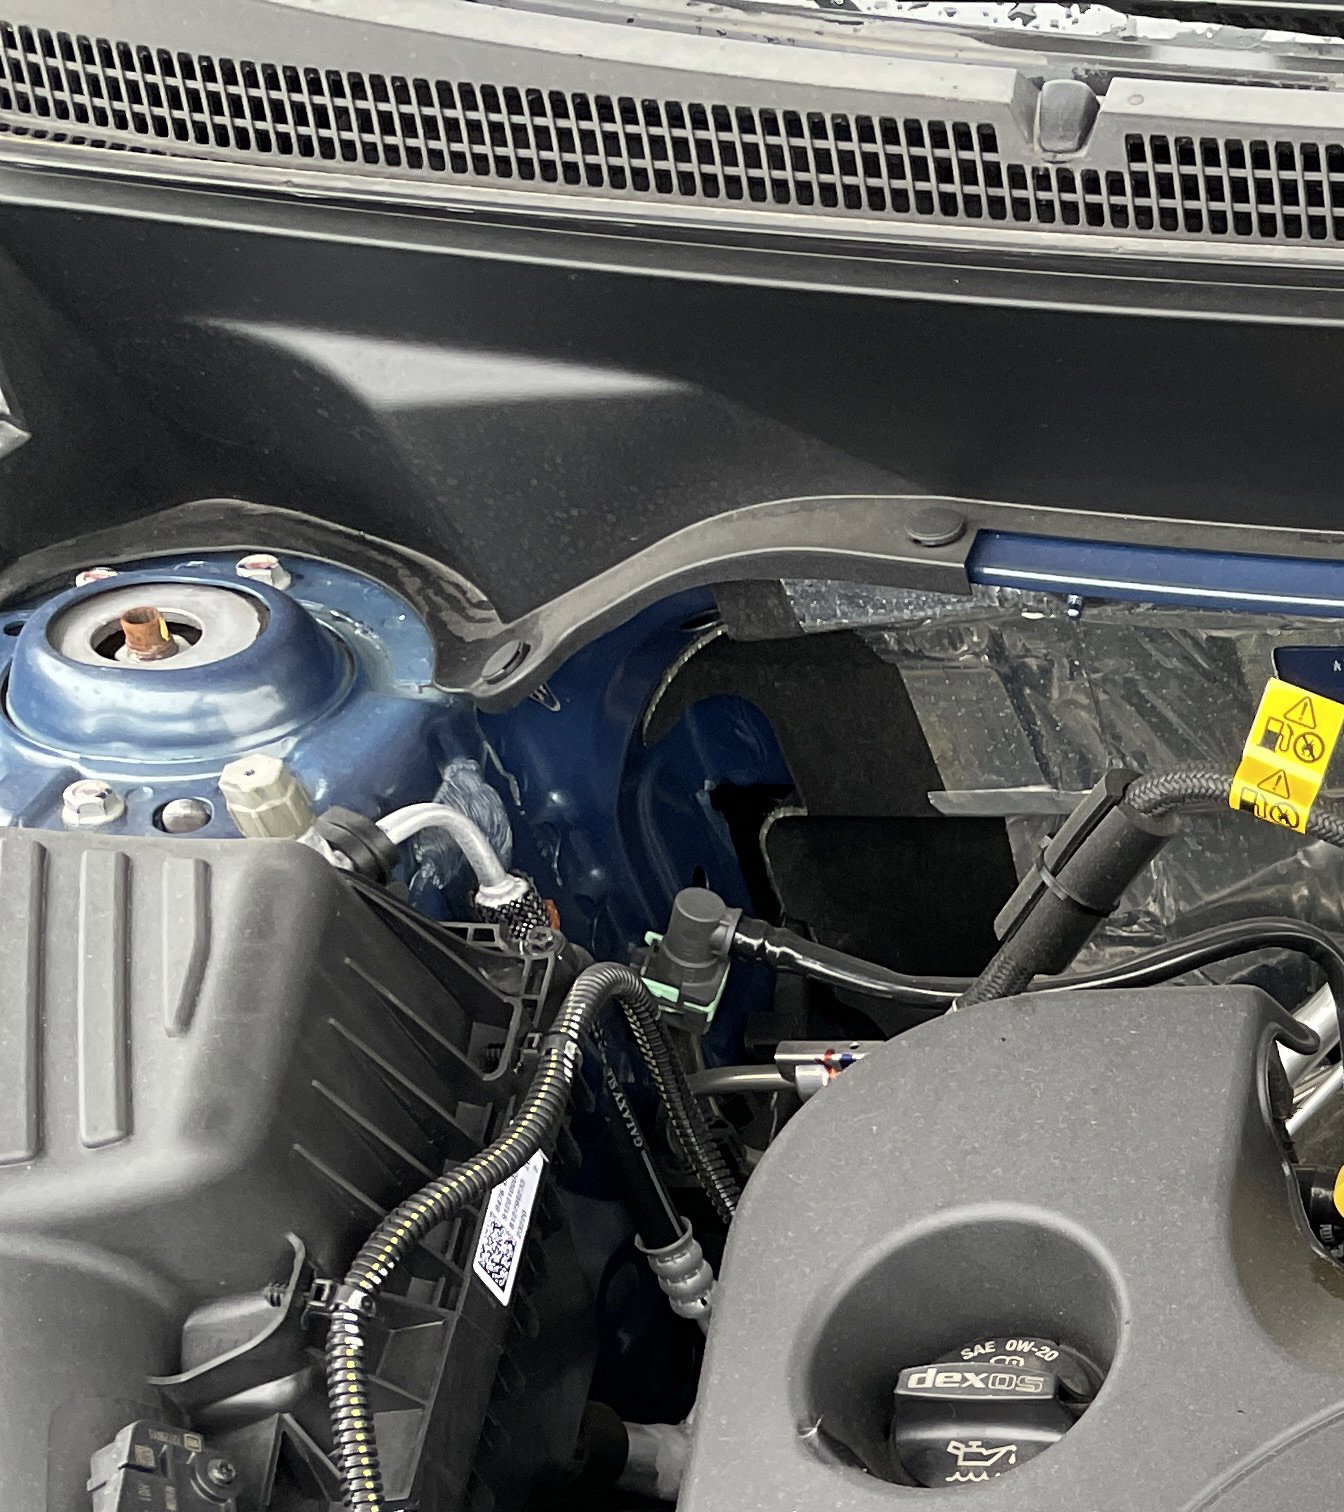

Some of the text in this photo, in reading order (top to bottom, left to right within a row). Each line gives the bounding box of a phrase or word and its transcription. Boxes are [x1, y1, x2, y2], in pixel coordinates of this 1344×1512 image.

[960, 1339, 1059, 1362] SAE 0W-20
[906, 1367, 1046, 1394] dexos
